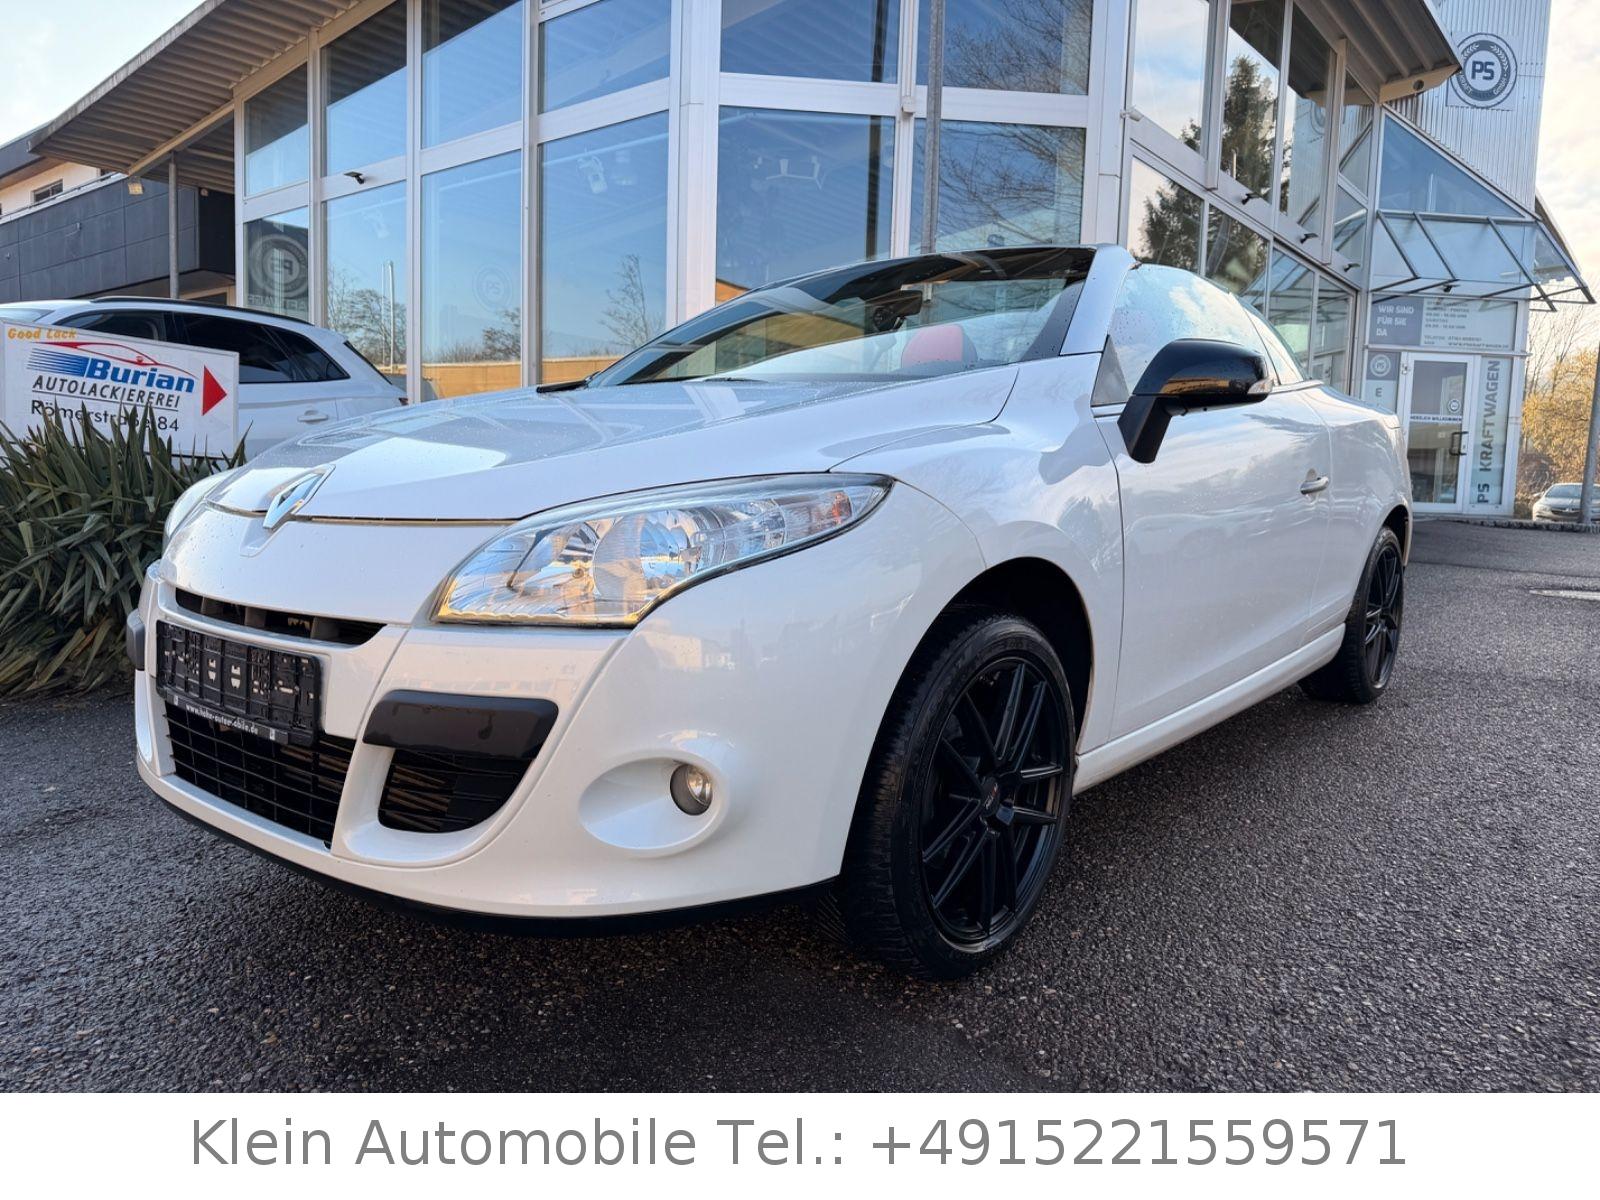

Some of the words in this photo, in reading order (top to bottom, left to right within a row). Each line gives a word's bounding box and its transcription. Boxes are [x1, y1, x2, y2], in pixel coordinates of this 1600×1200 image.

[1471, 60, 1495, 80] PS
[1378, 304, 1395, 313] WIR
[1396, 305, 1415, 314] SIND
[1377, 316, 1393, 325] FÜR
[7, 327, 41, 340] Good
[1376, 327, 1388, 337] DA
[86, 357, 195, 393] Burian
[32, 375, 181, 409] AUTOLACKIEREREI
[157, 416, 179, 432] 84
[1479, 360, 1501, 472] KRAFTWAGEN
[1477, 483, 1490, 504] PS
